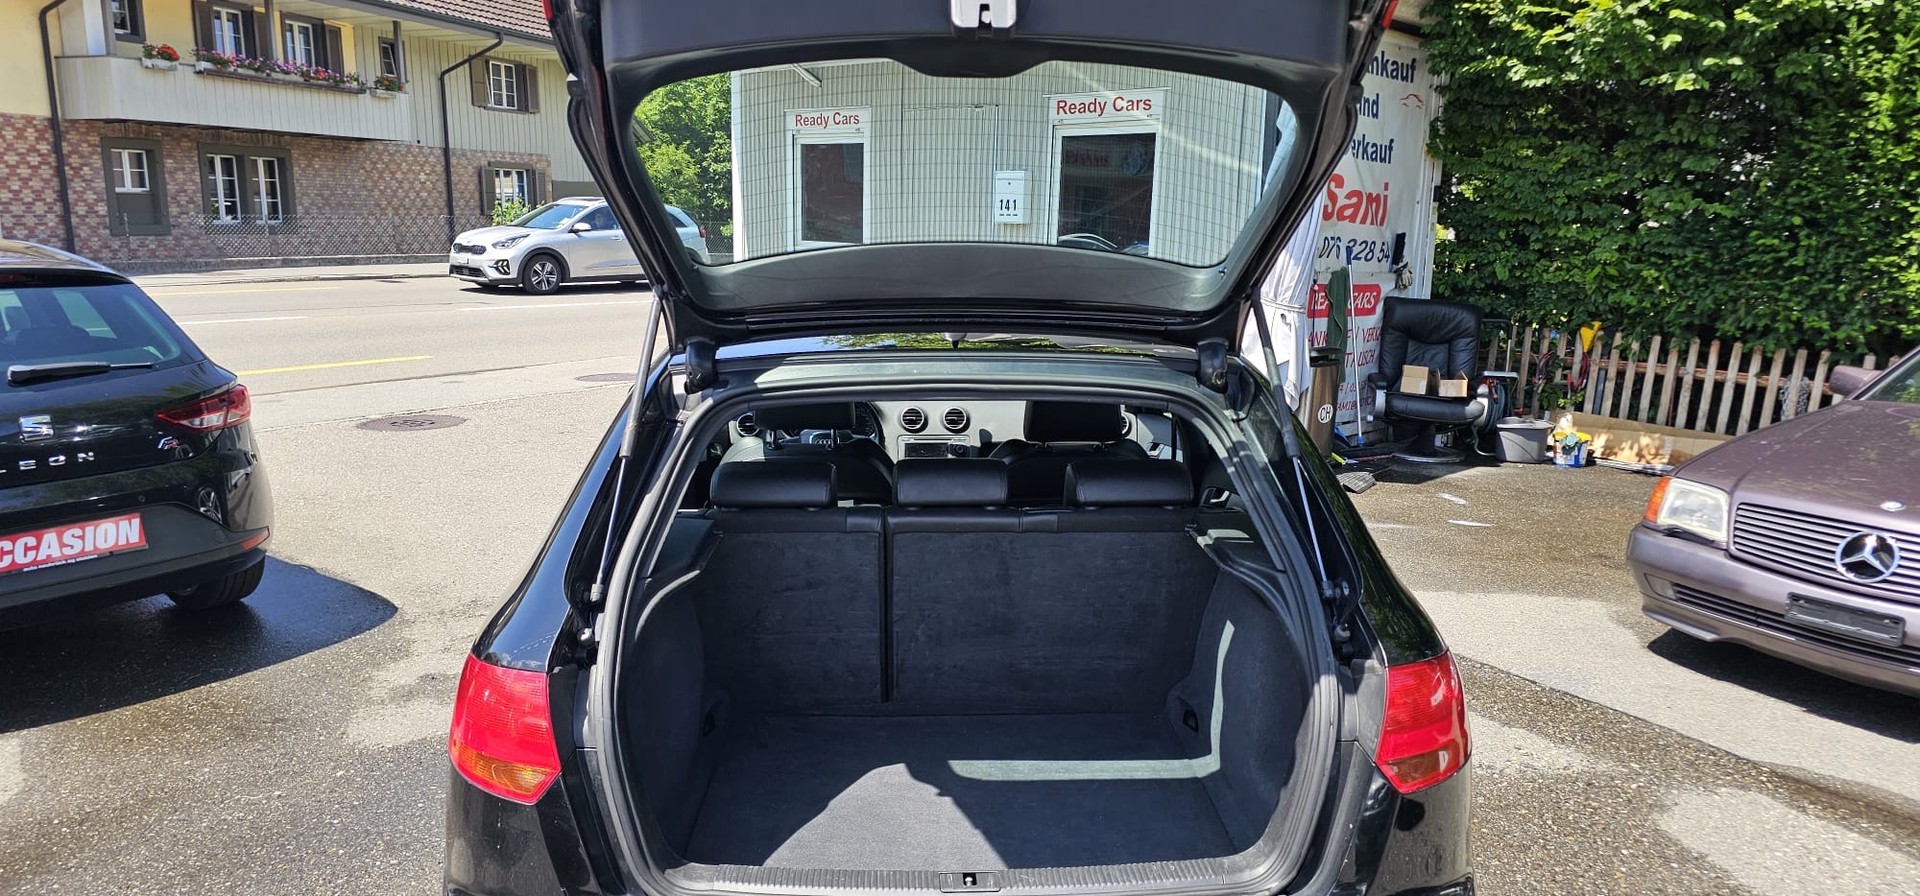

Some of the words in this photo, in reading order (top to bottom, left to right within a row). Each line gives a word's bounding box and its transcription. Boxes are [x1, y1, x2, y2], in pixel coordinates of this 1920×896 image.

[1367, 50, 1416, 83] nkauf
[1056, 97, 1107, 117] Ready
[1112, 96, 1152, 112] Cars
[795, 113, 829, 129] Ready
[833, 112, 860, 125] Cars
[1350, 134, 1394, 164] erkauf
[999, 199, 1018, 211] 141
[1319, 406, 1332, 421] CH
[0, 517, 140, 568] CCASION
